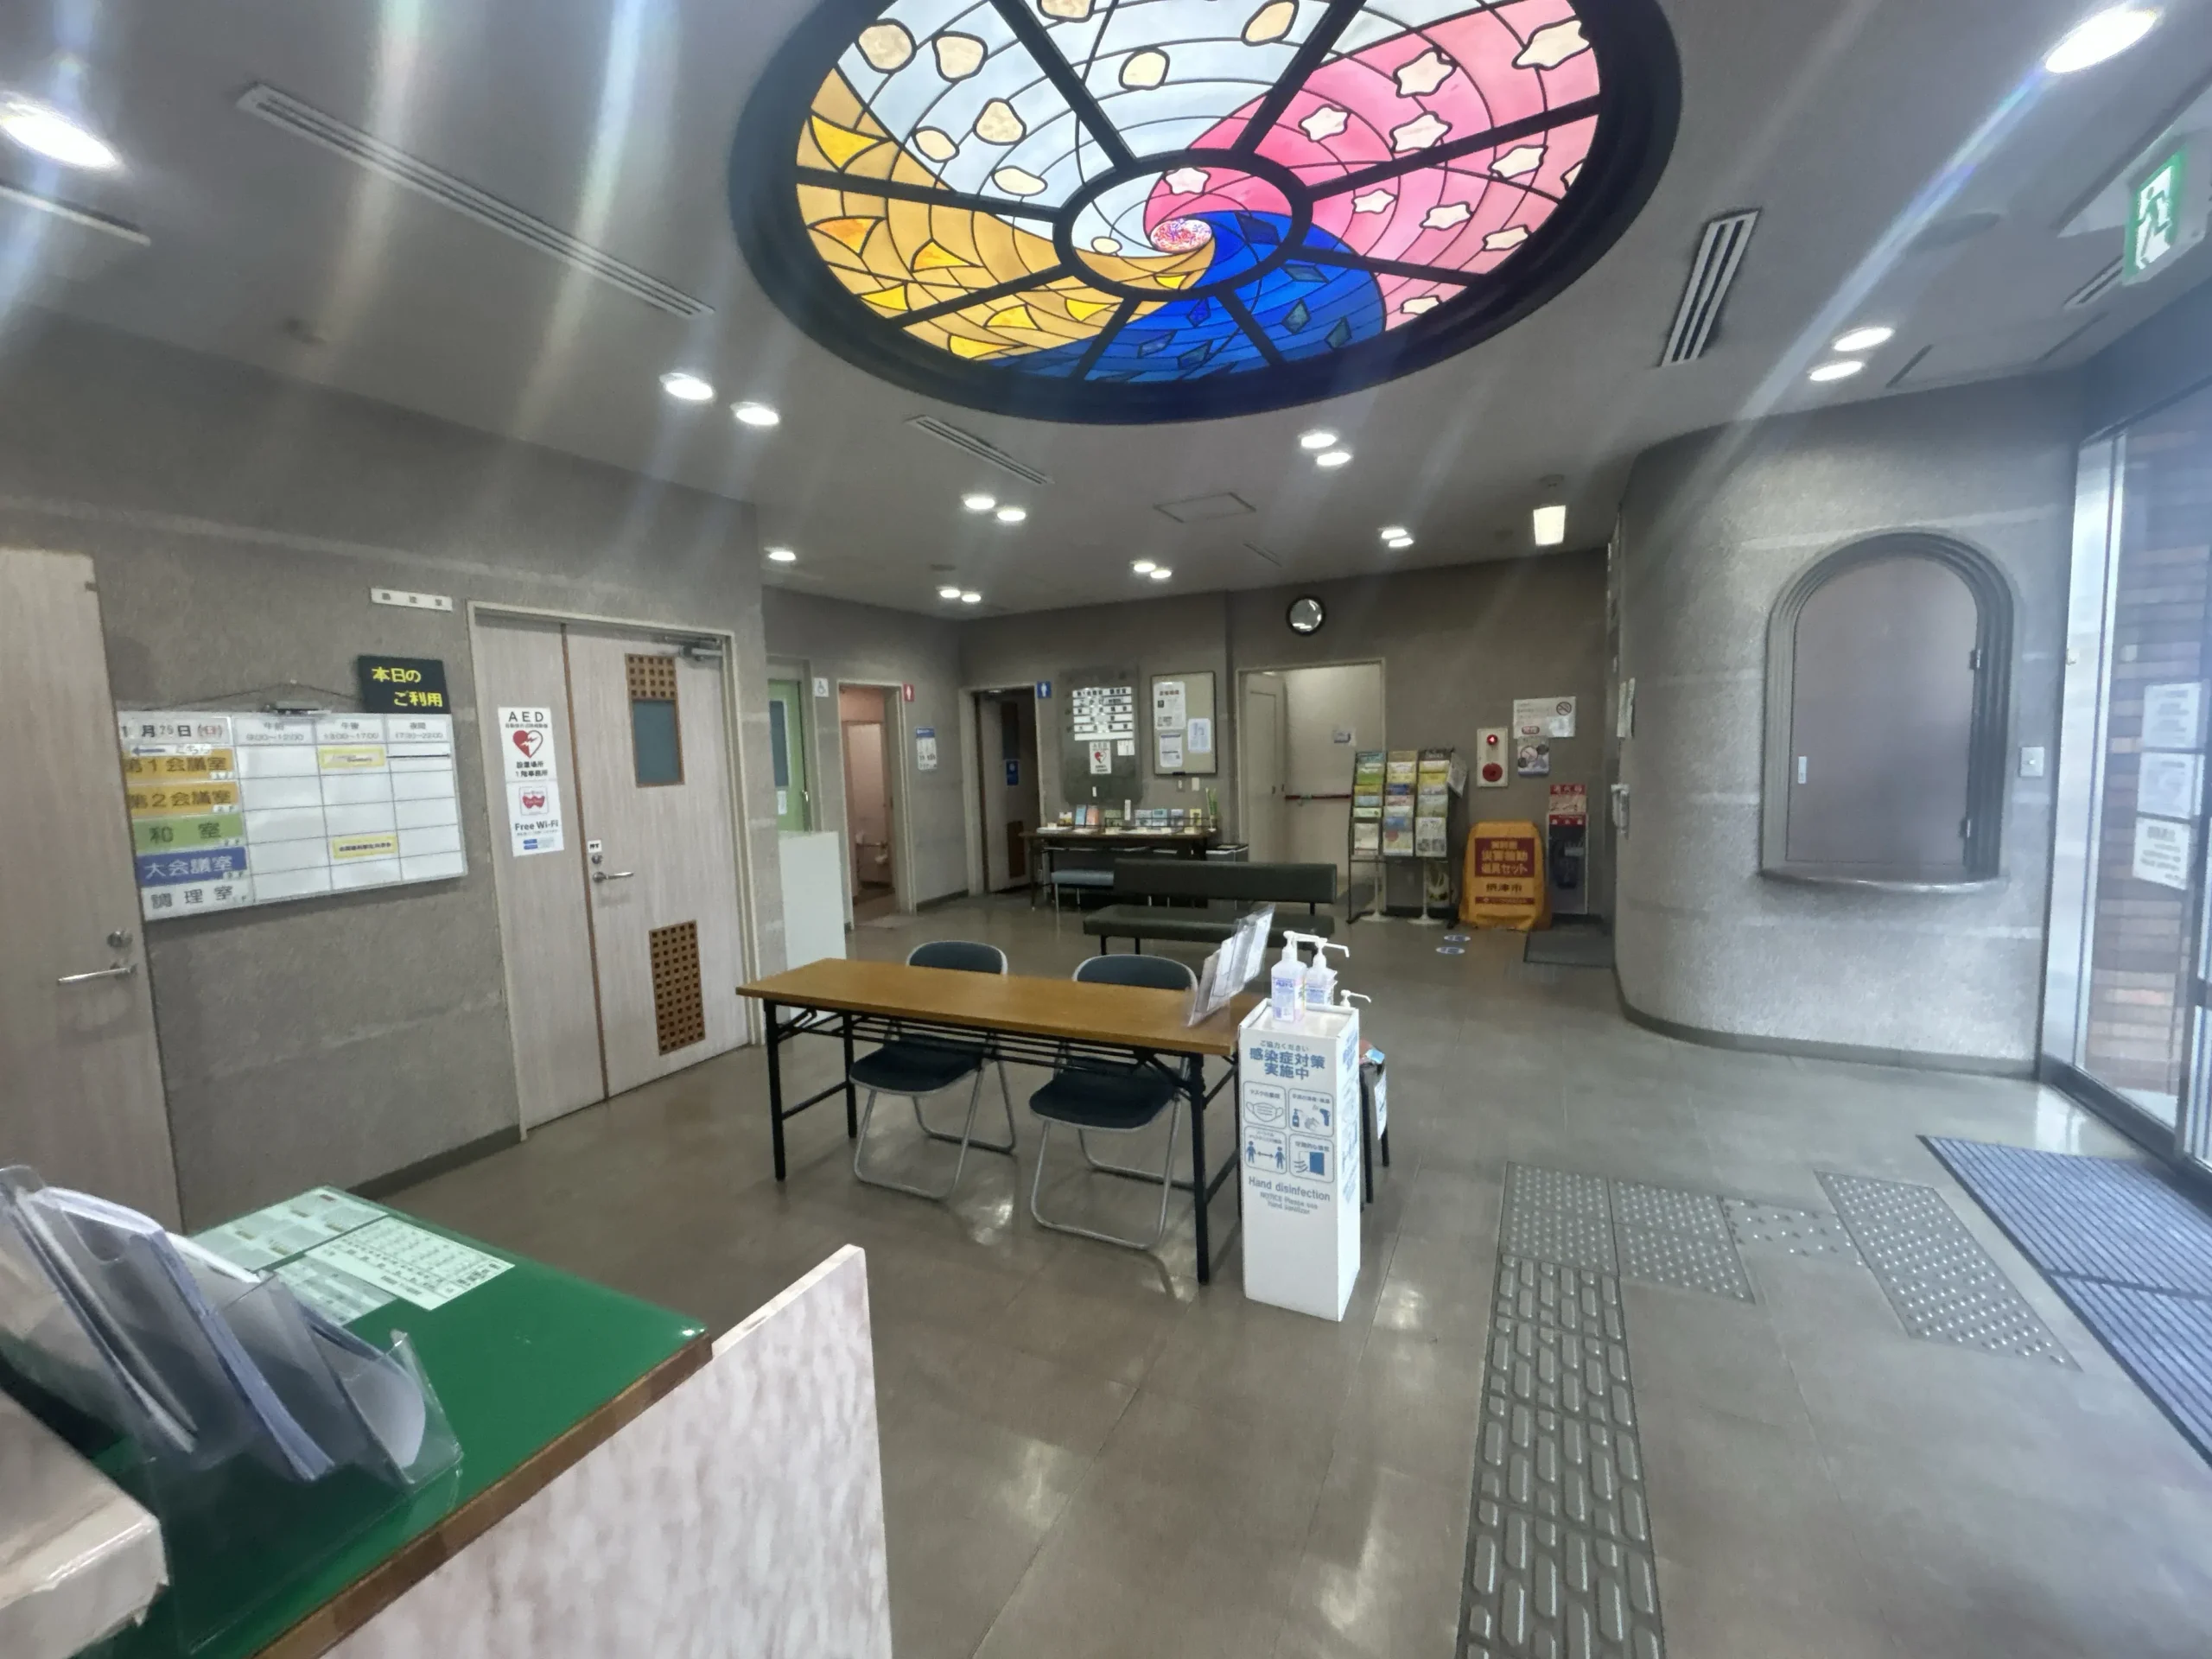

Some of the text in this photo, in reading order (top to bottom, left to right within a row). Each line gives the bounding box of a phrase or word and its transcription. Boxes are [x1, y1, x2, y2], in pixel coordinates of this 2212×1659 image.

[372, 666, 422, 683] 本日の
[394, 690, 442, 707] ご利用
[508, 711, 544, 722] AED
[149, 822, 221, 843] 和室
[515, 819, 559, 831] Free Wi-Fi
[145, 855, 233, 880] 大会議室
[151, 885, 233, 909] 調理室
[1260, 1040, 1309, 1052] ご協力ください
[1249, 1047, 1325, 1070] 感染症対策
[1264, 1062, 1309, 1080] 実施中
[1249, 1176, 1272, 1190] Hand
[1275, 1181, 1331, 1201] disinfection
